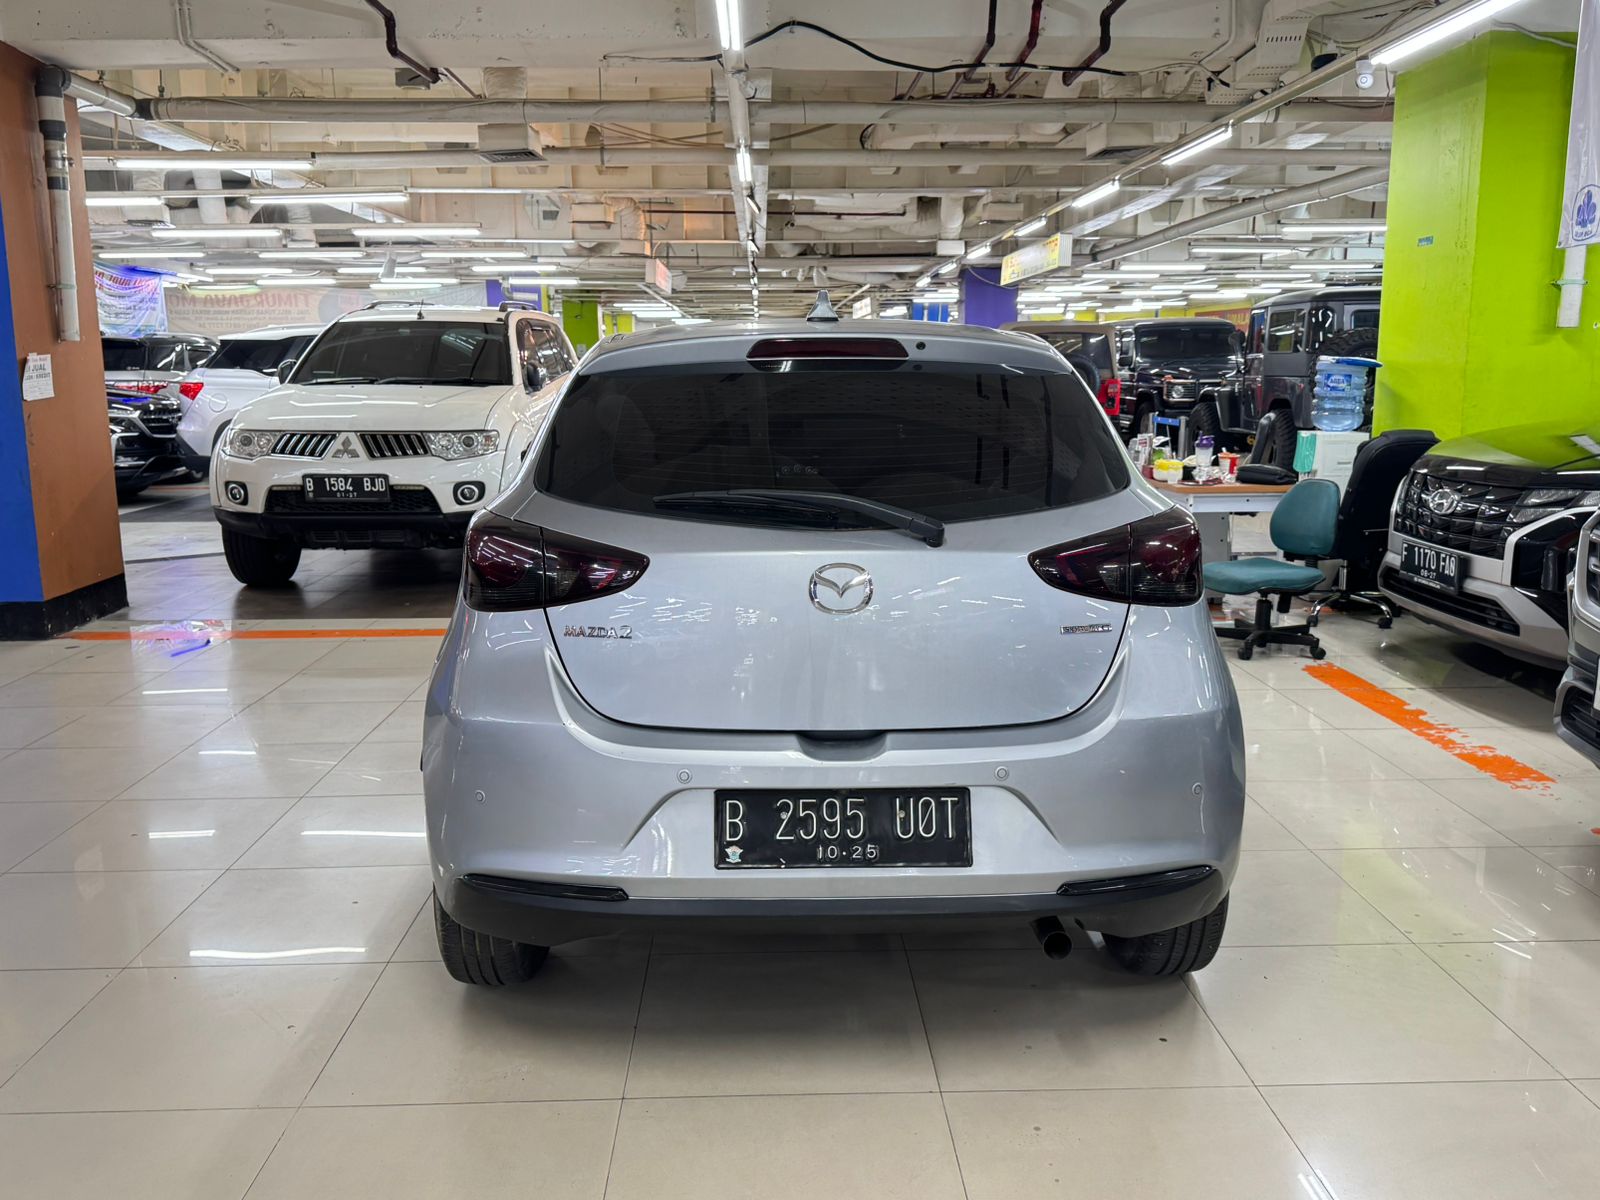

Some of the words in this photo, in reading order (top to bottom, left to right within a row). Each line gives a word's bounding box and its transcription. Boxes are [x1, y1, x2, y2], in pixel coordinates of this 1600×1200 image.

[306, 477, 314, 491] B
[324, 477, 353, 492] 1584
[363, 477, 386, 492] BJD
[1402, 543, 1408, 562] F
[1414, 547, 1437, 569] 1170
[724, 799, 744, 841] B
[776, 797, 865, 840] 2595
